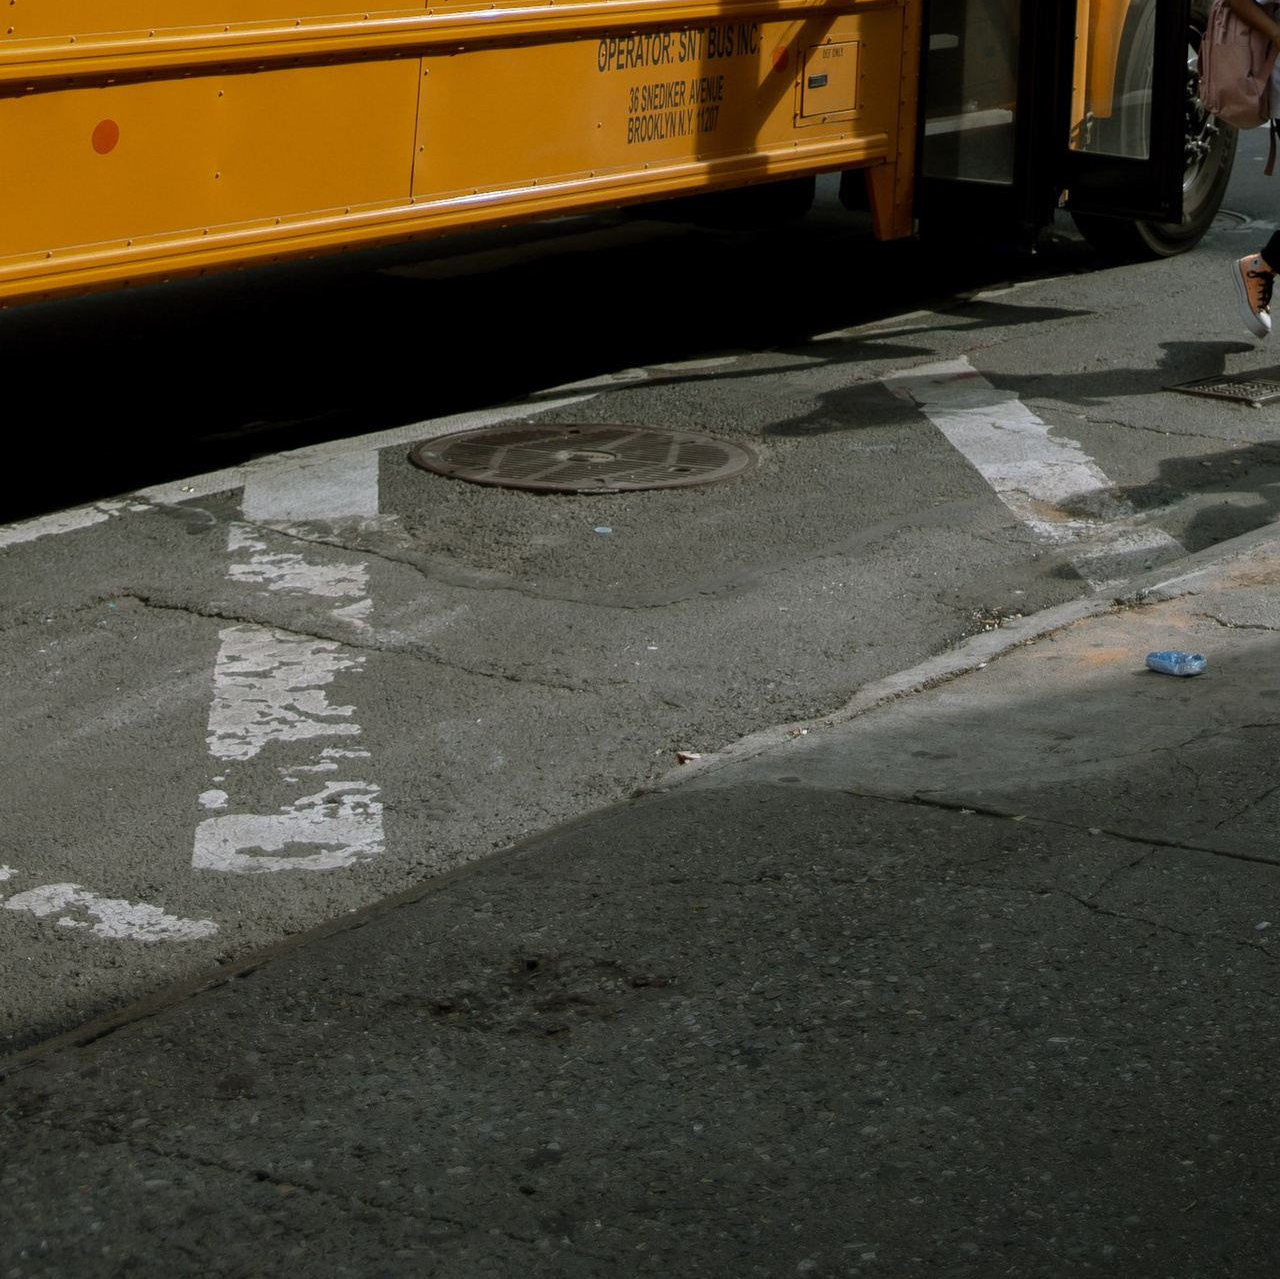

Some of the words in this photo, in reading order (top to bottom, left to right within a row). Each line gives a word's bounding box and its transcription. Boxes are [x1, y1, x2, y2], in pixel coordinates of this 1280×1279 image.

[597, 28, 675, 73] OPERATOR:
[678, 28, 705, 63] SNT
[707, 23, 734, 60] BUS
[736, 22, 760, 57] INC.
[628, 87, 639, 114] 36
[640, 81, 686, 113] SNEDIKER
[689, 75, 724, 104] AVENUE
[627, 108, 676, 145] BROOKLYN
[677, 106, 695, 137] N.Y.
[696, 105, 720, 133] 11207
